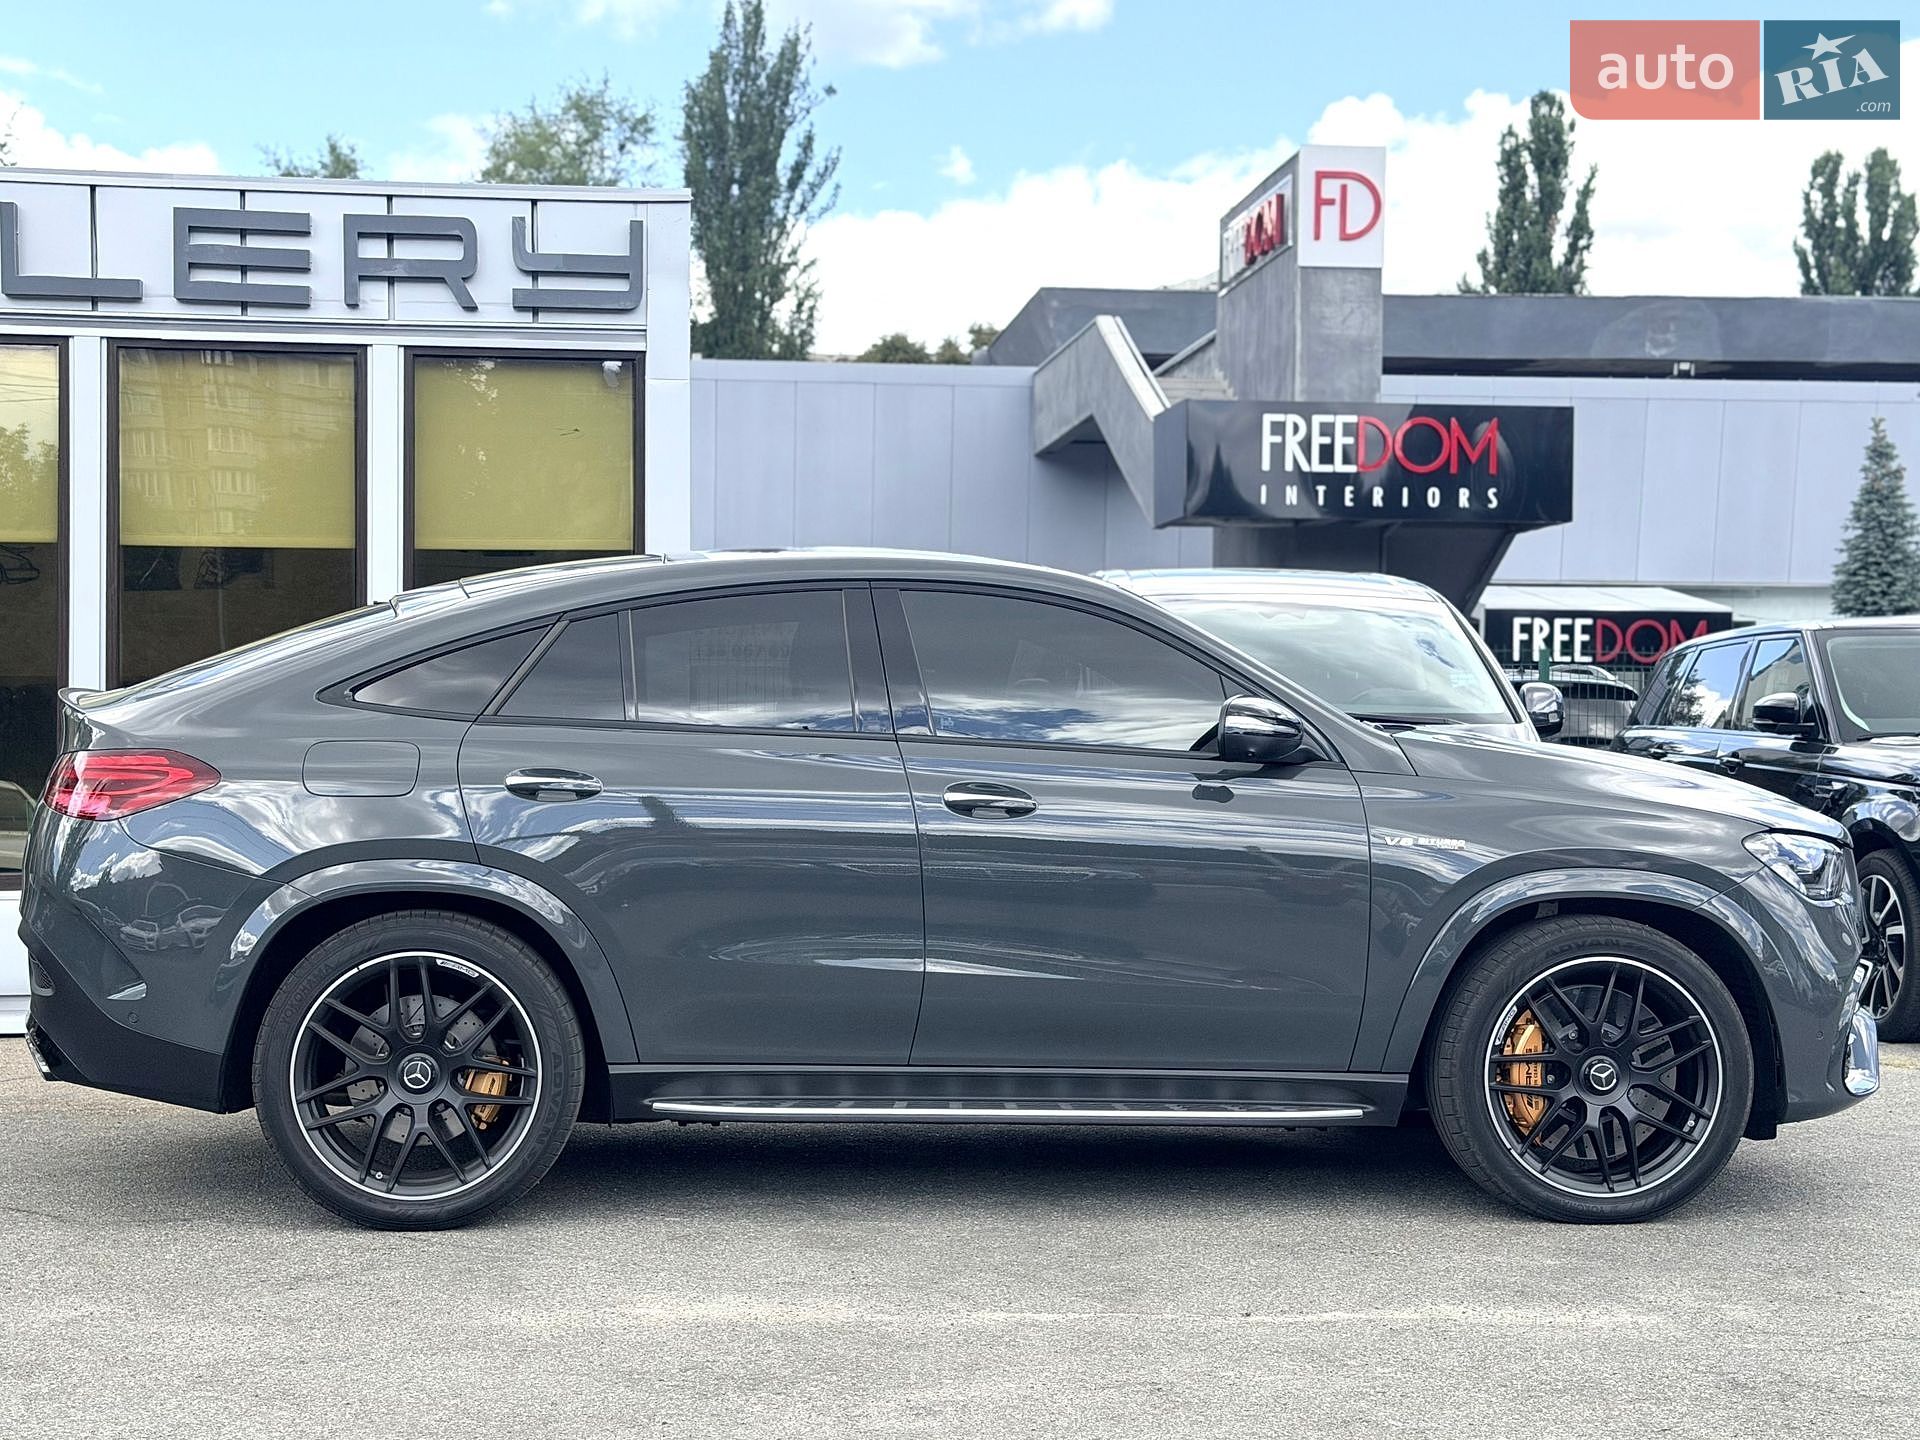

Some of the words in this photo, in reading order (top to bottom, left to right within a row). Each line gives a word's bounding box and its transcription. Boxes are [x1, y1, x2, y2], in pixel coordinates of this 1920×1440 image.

[1313, 169, 1383, 242] FD
[1260, 412, 1500, 478] FREEDOM
[1260, 484, 1500, 511] INTERIORS
